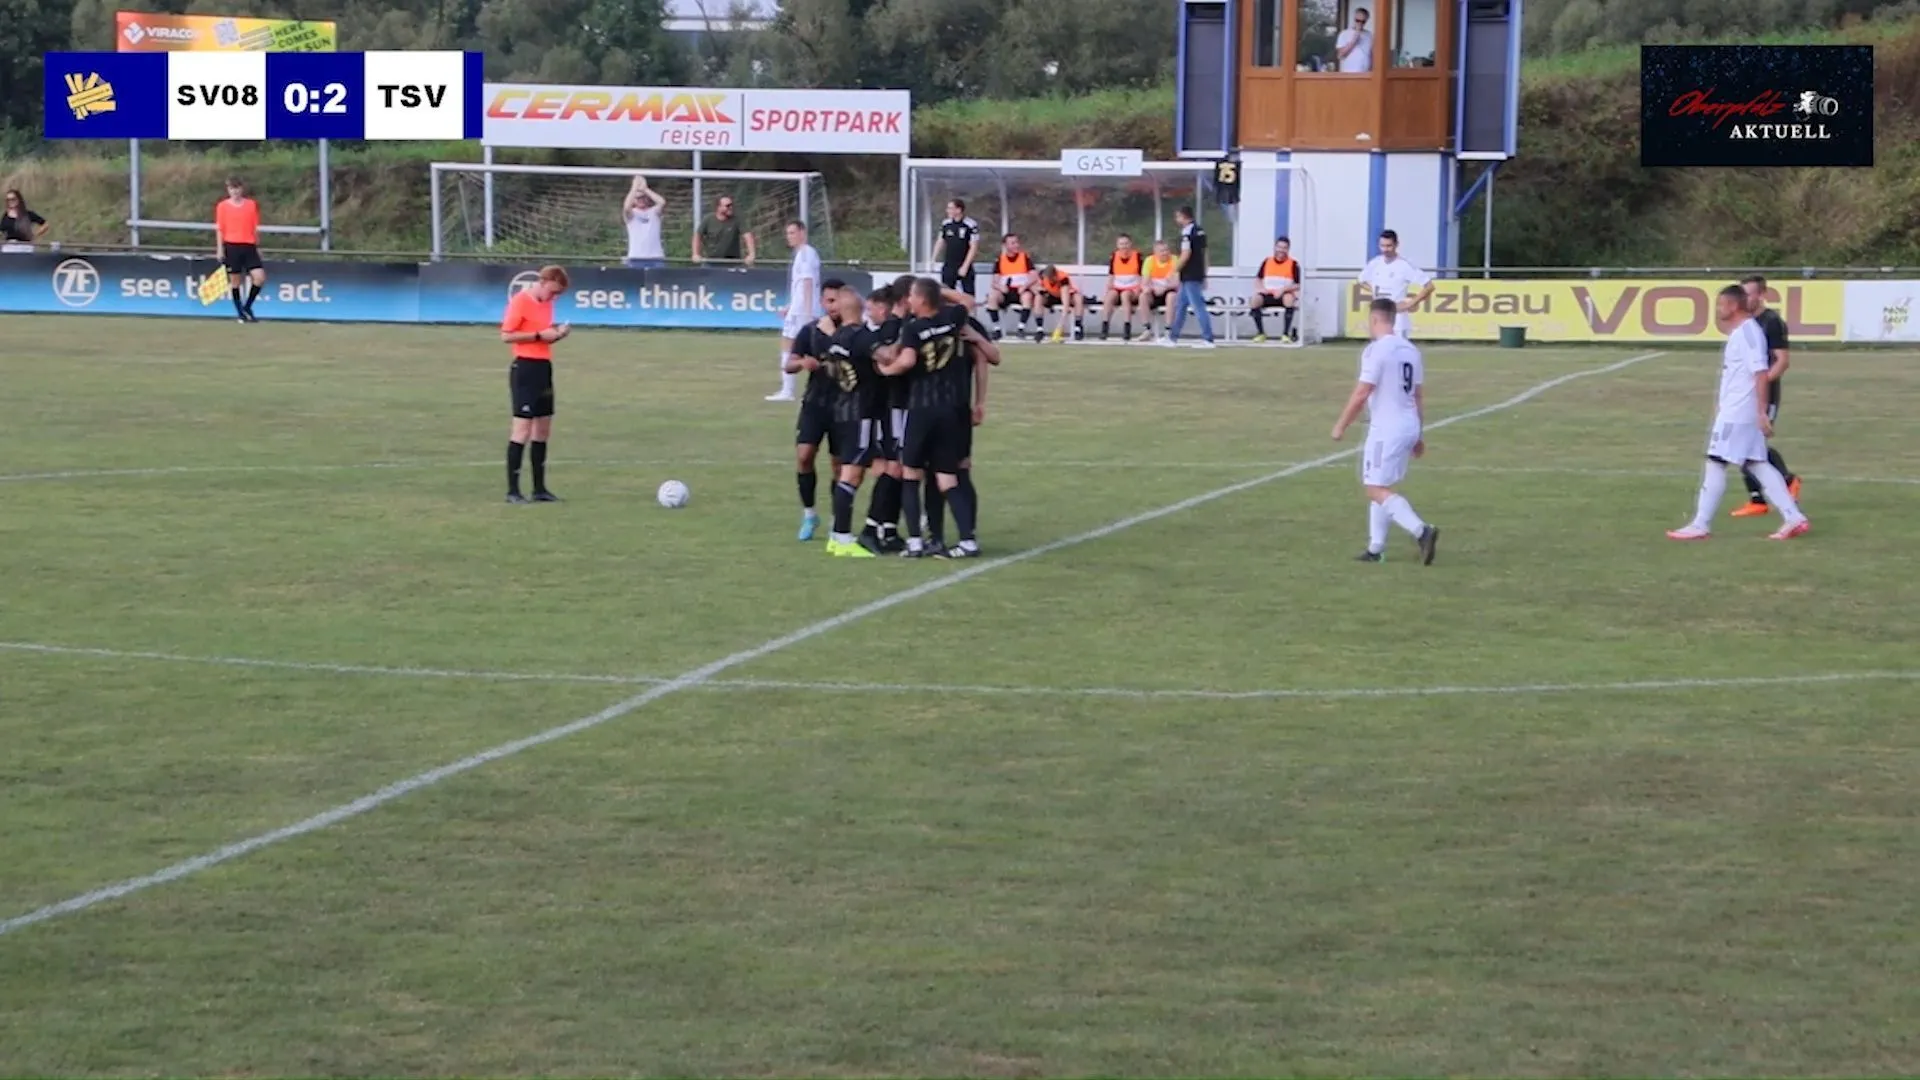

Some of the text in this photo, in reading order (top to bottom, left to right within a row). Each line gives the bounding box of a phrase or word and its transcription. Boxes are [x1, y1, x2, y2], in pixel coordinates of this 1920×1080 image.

[278, 29, 318, 48] COMES
[486, 89, 737, 124] CERMAK
[750, 109, 903, 134] SPORTPARK
[660, 126, 731, 147] reisen
[1077, 155, 1127, 172] GAST
[59, 269, 93, 296] ZF
[121, 275, 178, 299] see.
[278, 279, 331, 302] act.
[575, 283, 785, 312] see. think. act.
[1403, 362, 1414, 394] 9
